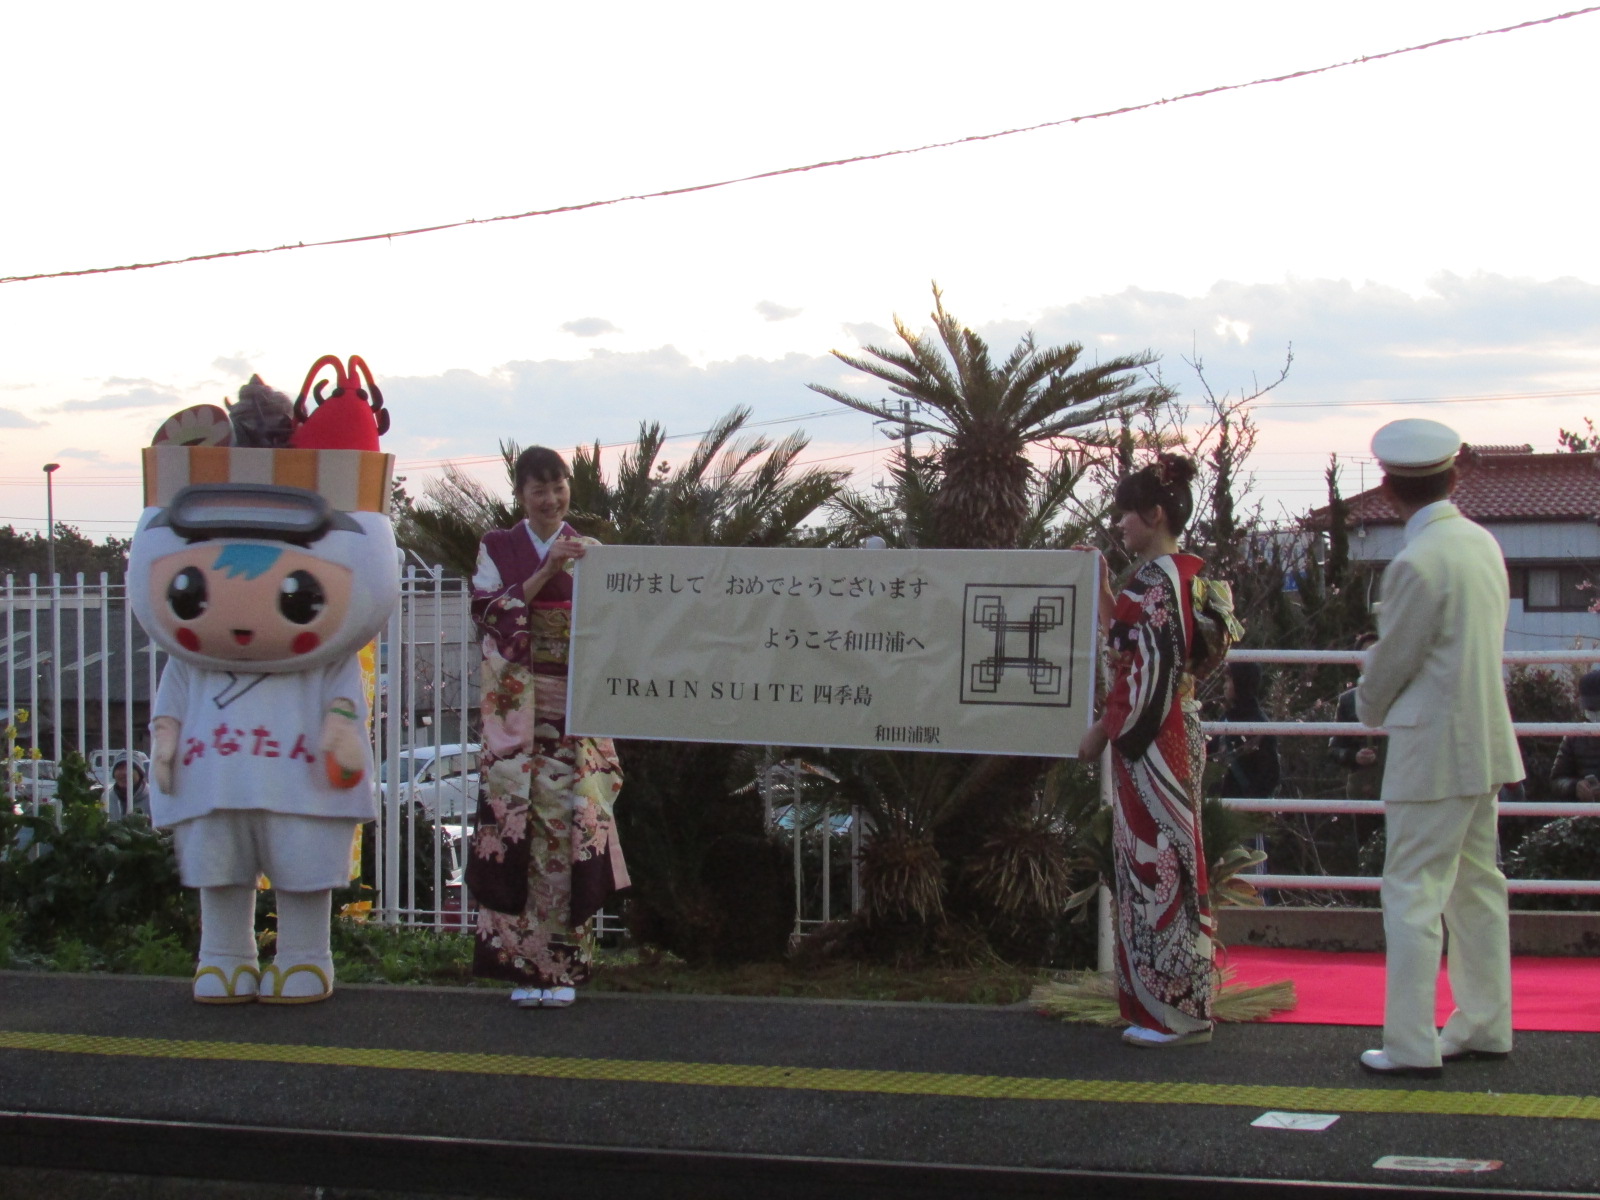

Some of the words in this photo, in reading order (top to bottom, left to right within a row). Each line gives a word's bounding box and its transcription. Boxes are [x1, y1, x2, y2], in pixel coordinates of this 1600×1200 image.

[608, 573, 704, 594] 明けまして
[725, 575, 929, 599] おめでとうございます
[765, 628, 925, 652] ようこそ和田浦へ
[607, 678, 699, 698] TRAIN
[711, 682, 804, 702] SUITE
[813, 685, 872, 706] 四季島
[183, 724, 316, 766] みなたん
[875, 725, 940, 743] 和田浦駅
